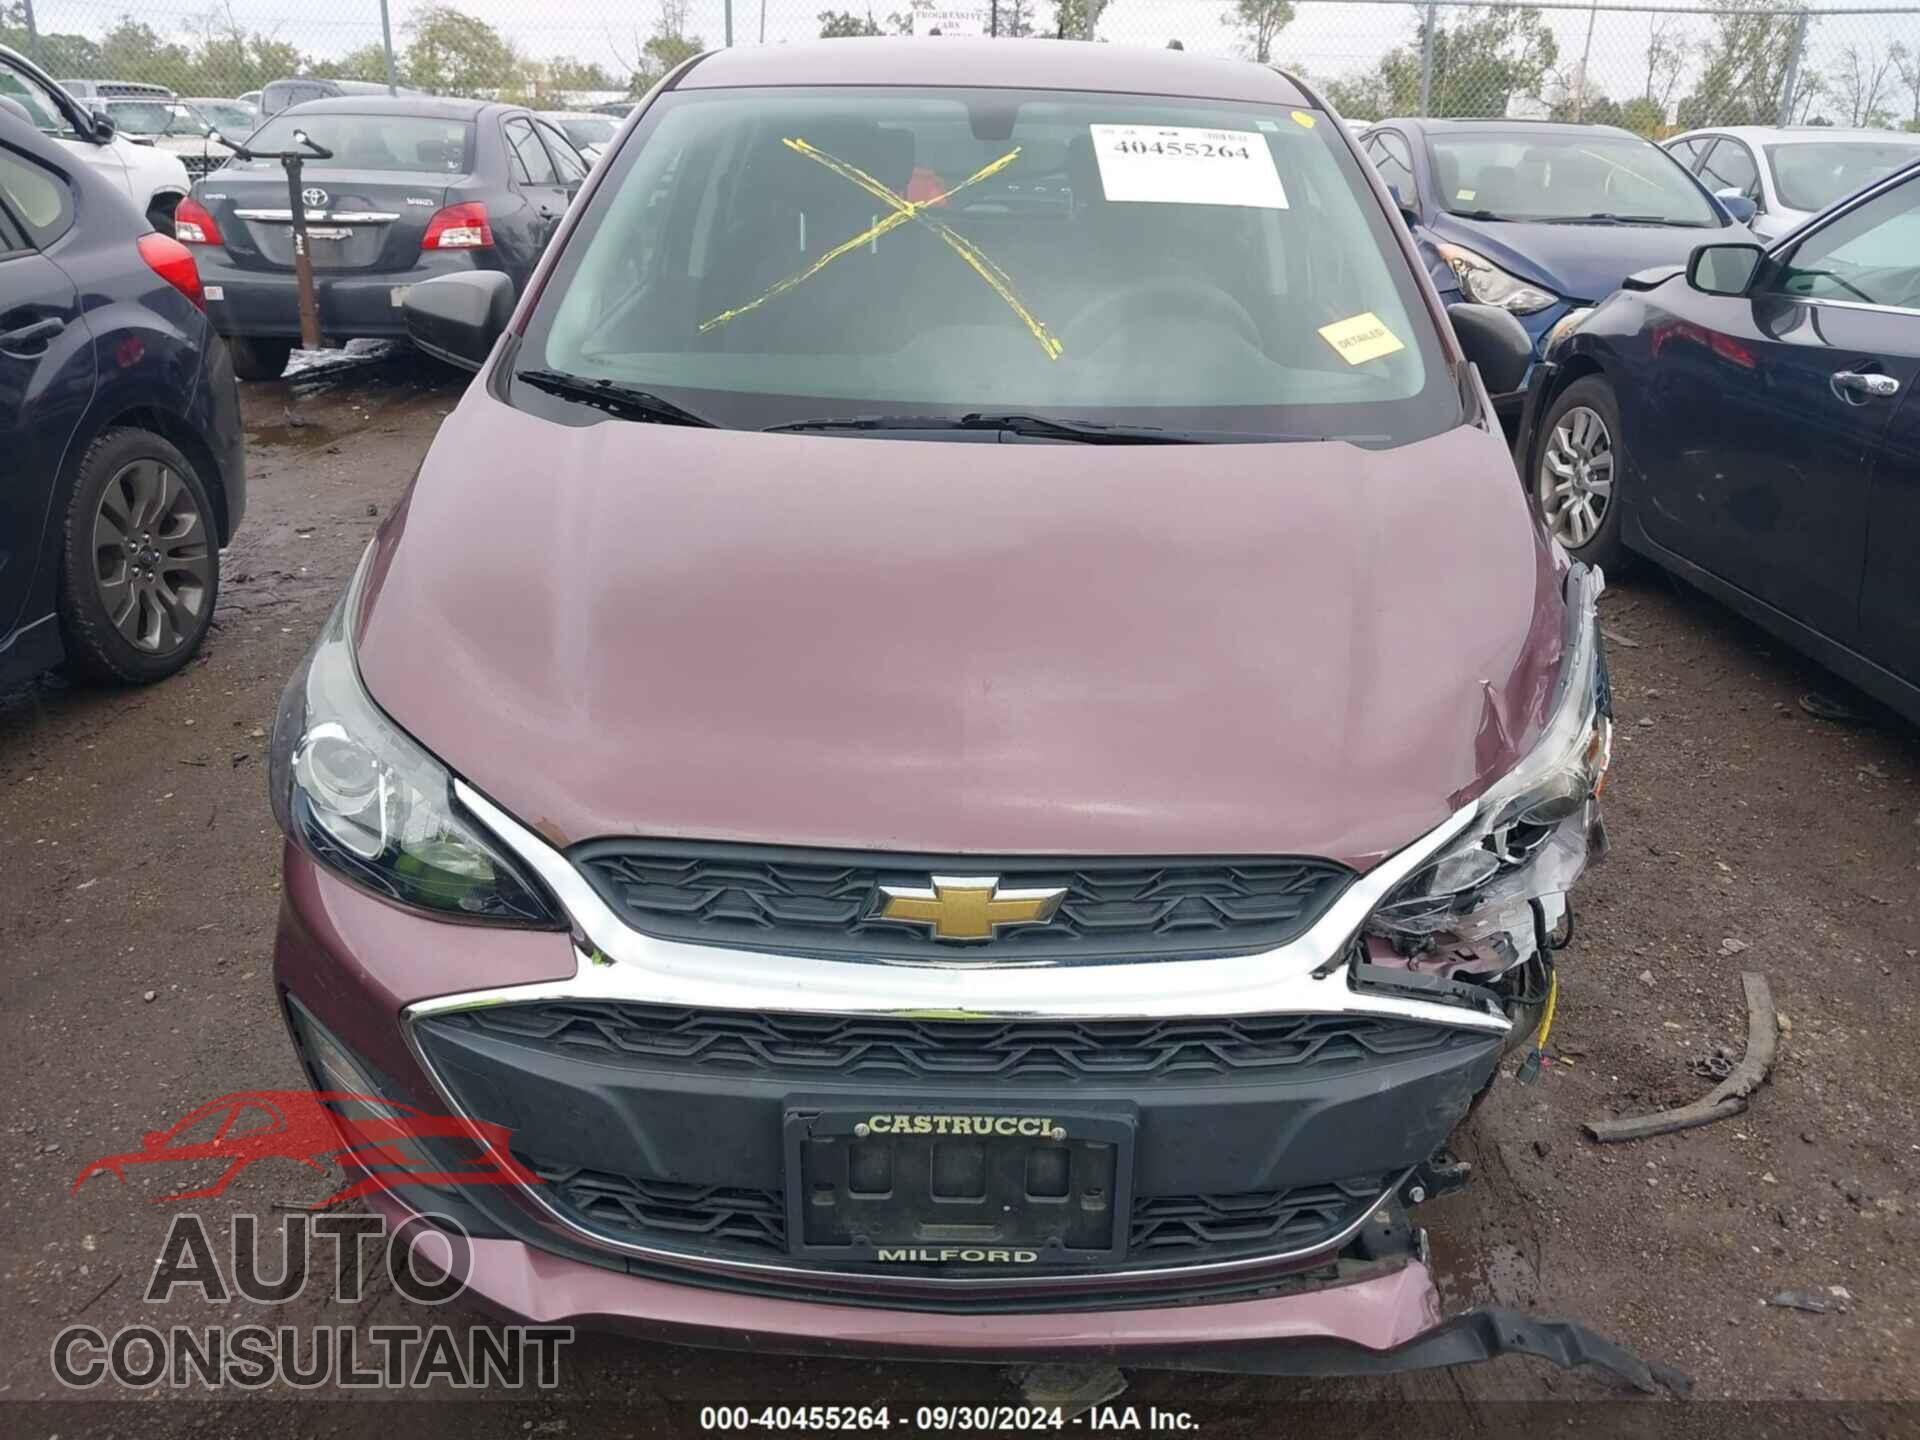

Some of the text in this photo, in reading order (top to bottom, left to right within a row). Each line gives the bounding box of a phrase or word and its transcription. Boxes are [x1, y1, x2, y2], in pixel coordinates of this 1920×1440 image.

[1113, 139, 1250, 160] 40455264
[868, 1114, 1054, 1137] CASTRUCCI
[877, 1248, 1039, 1264] MILFORD
